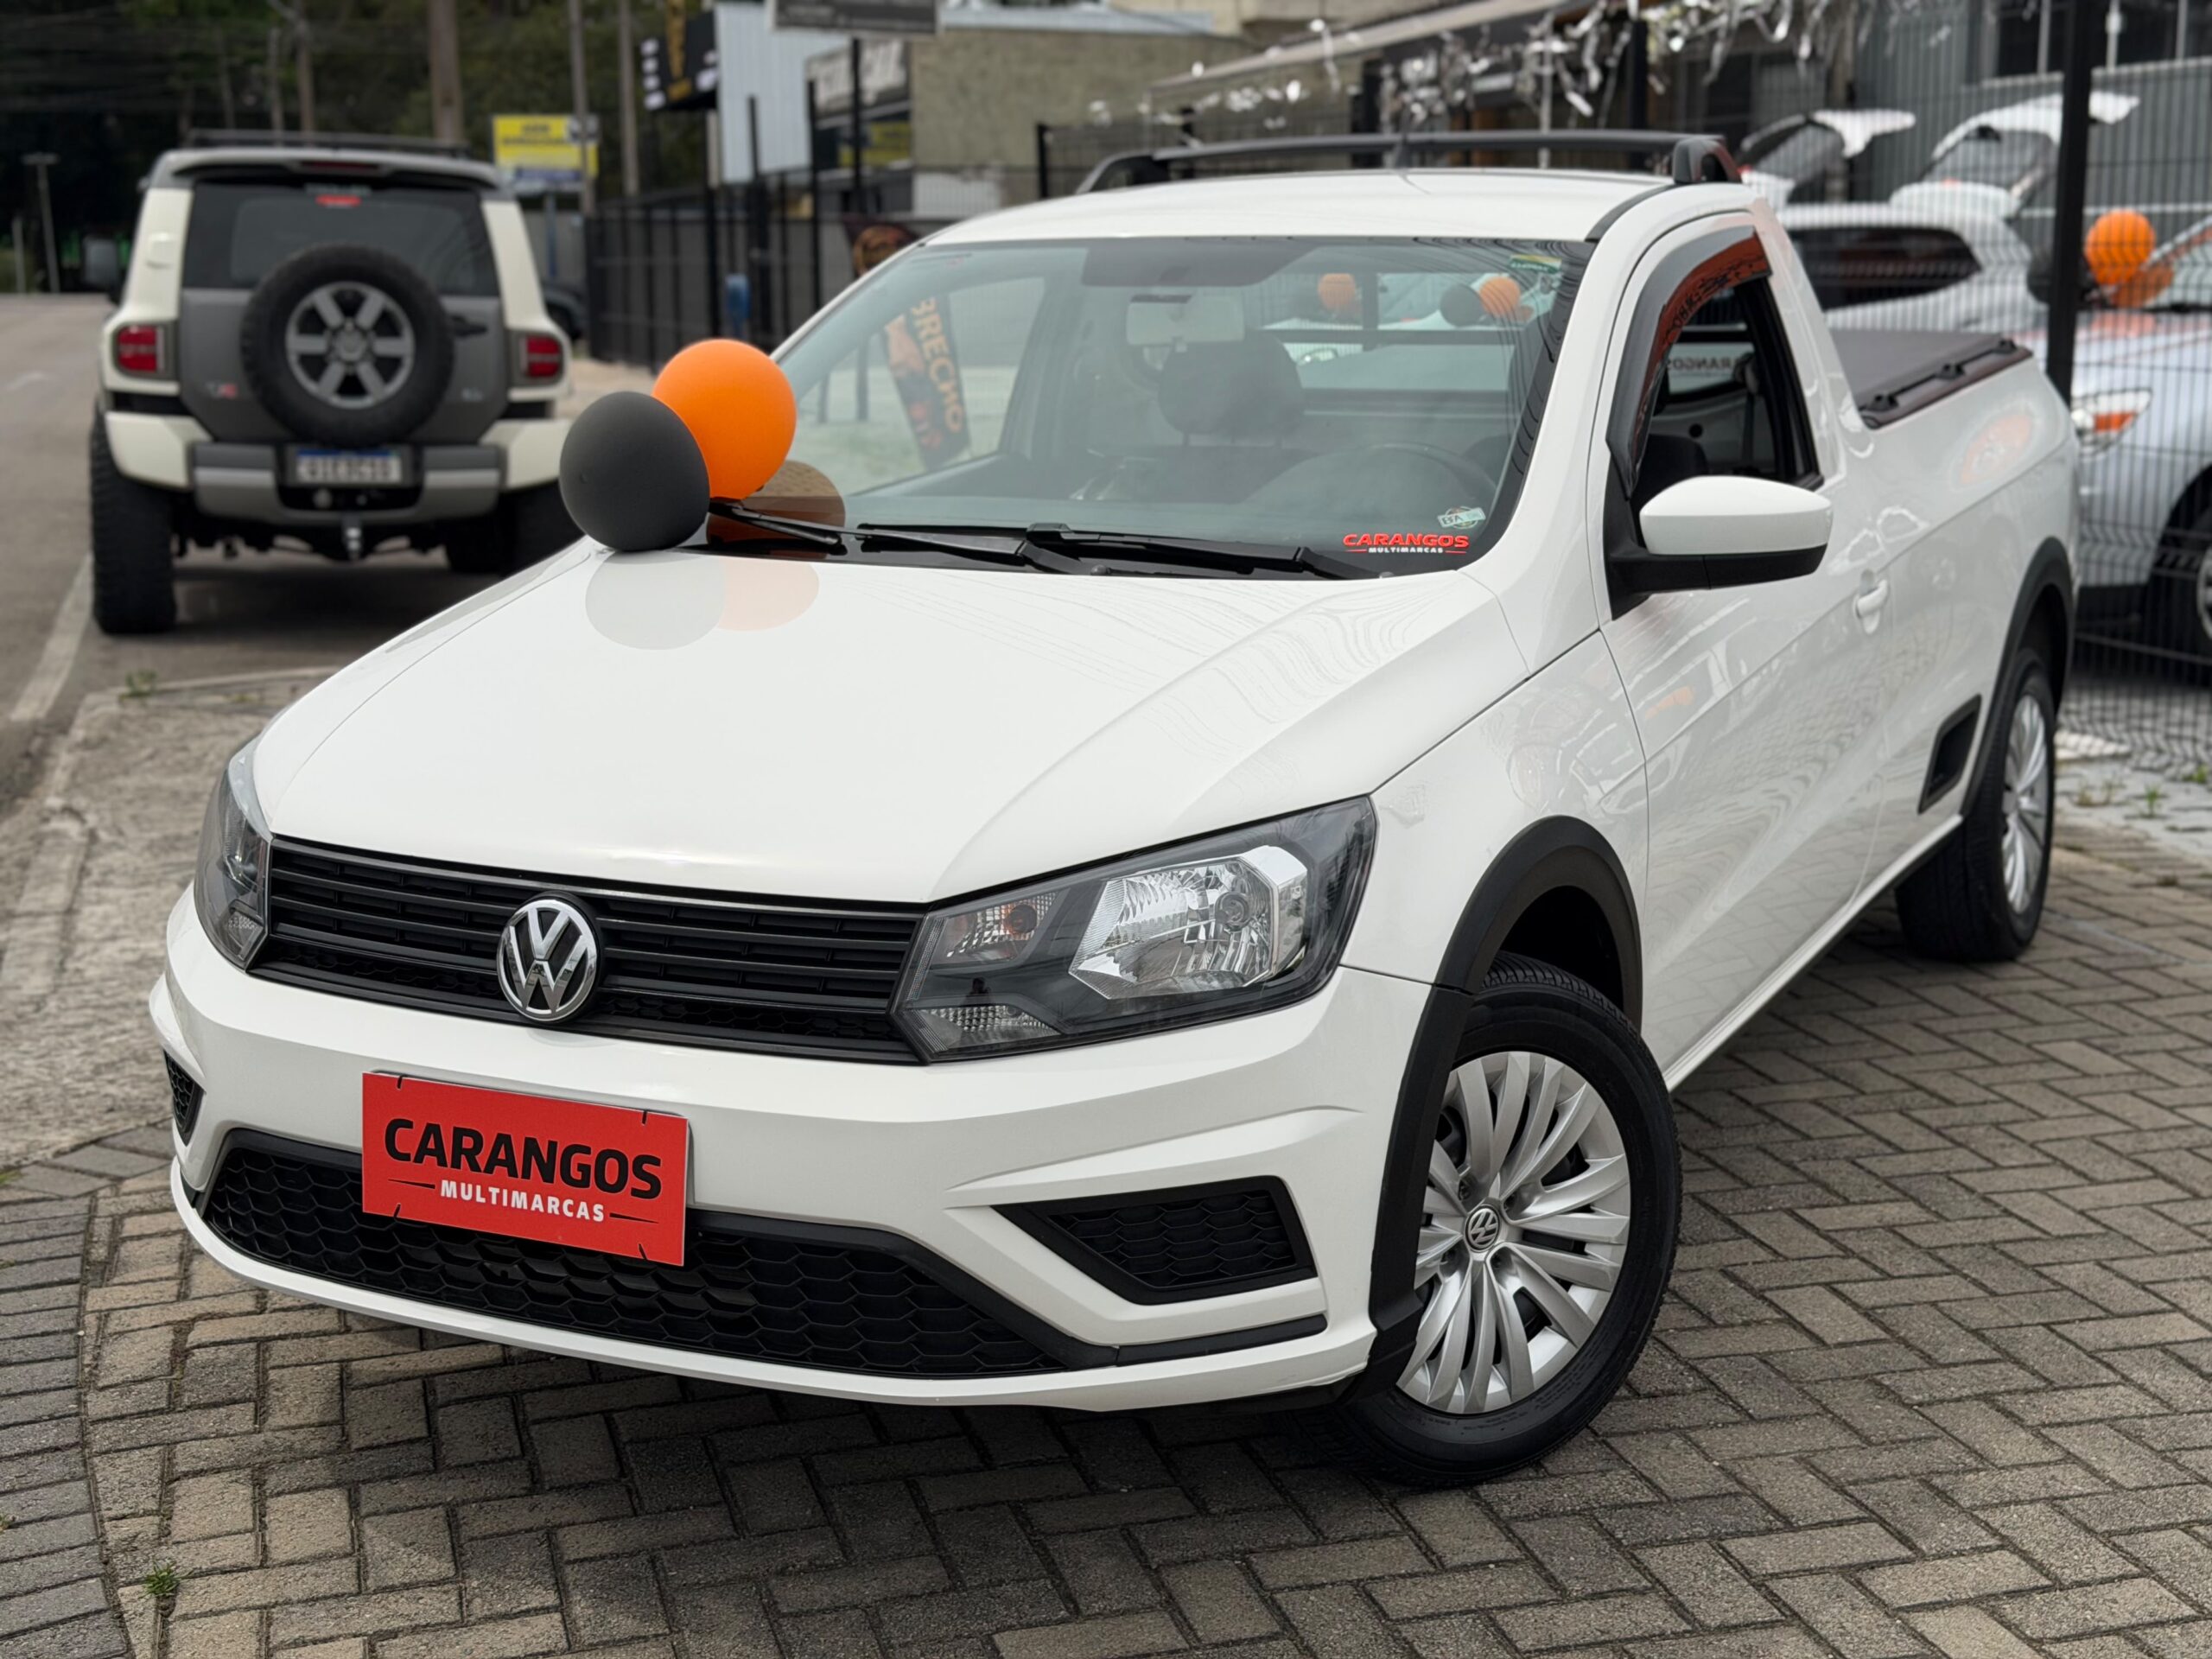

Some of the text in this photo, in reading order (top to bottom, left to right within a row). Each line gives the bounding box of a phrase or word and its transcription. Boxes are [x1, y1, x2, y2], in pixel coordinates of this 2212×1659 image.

[1343, 533, 1470, 548] CARANGOS
[385, 1118, 663, 1199] CARANGOS
[441, 1179, 604, 1222] MULTIMARCAS
